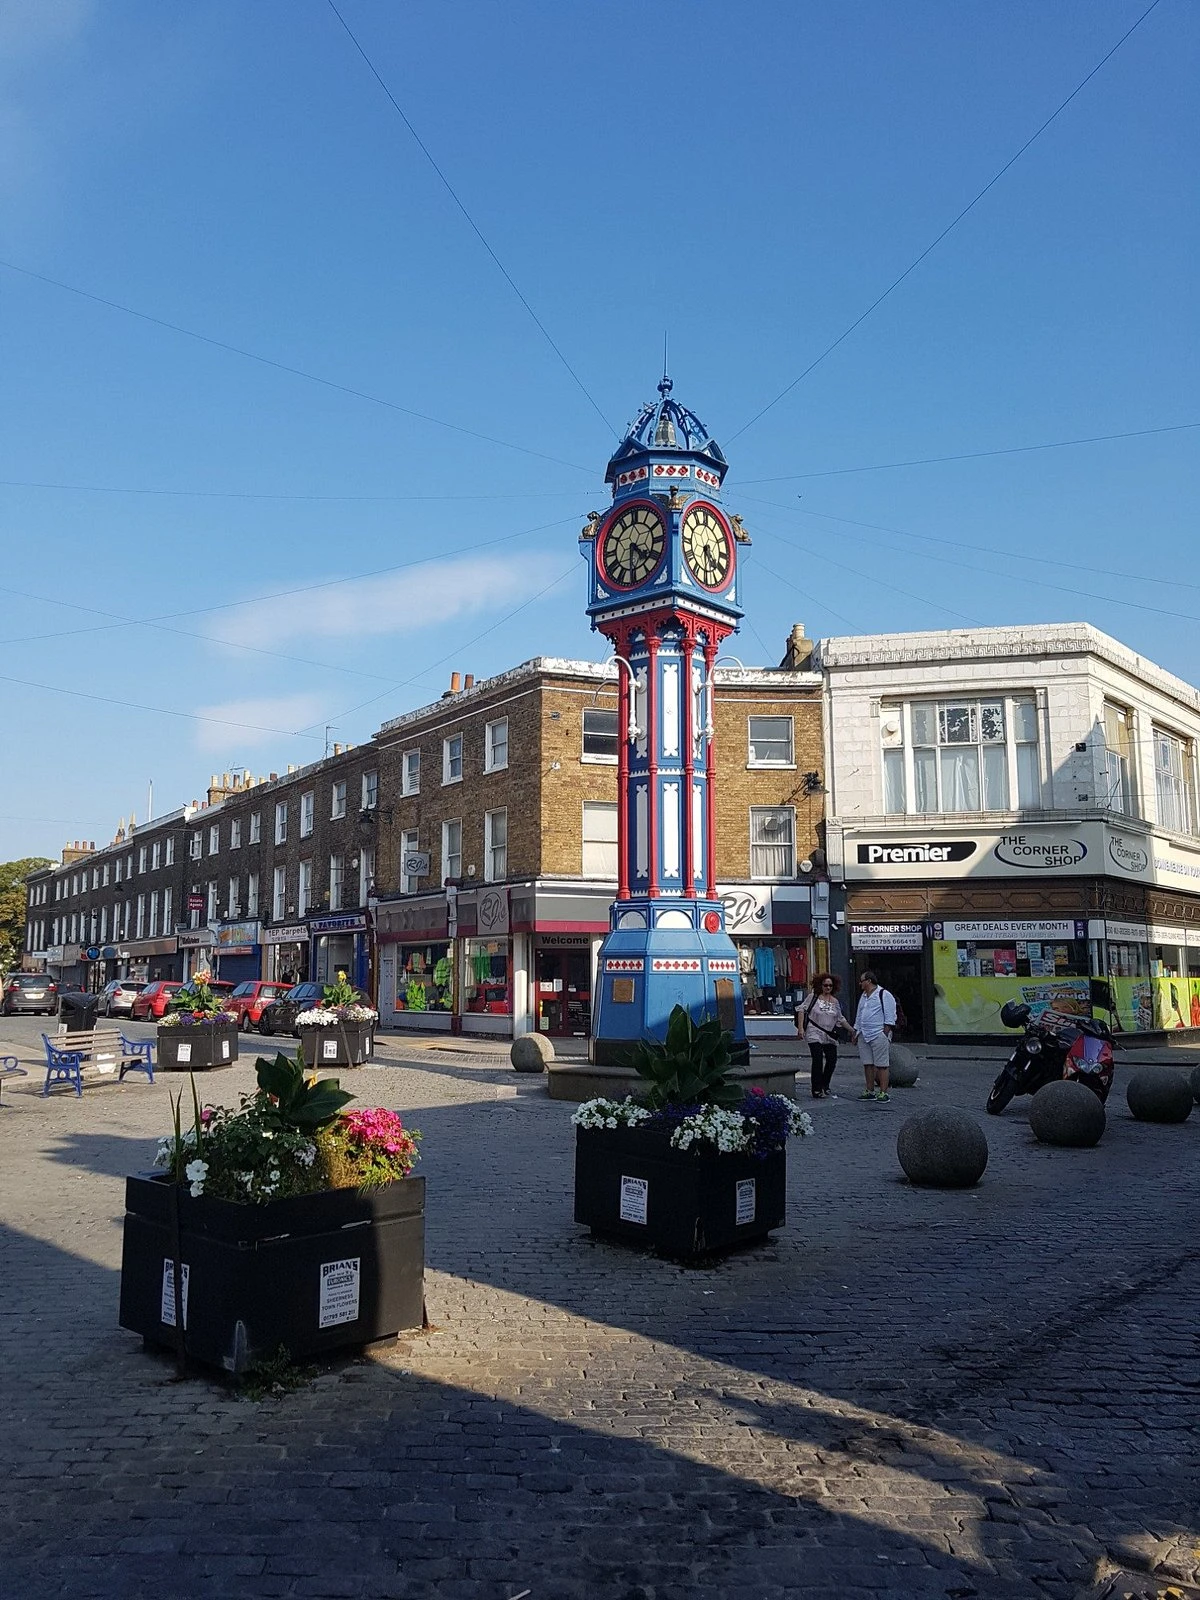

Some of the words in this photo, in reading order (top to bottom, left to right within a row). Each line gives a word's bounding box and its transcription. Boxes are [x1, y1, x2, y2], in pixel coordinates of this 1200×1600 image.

[1000, 835, 1026, 846] THE
[1110, 836, 1123, 848] THE
[868, 843, 952, 863] Premier
[1012, 845, 1069, 856] CORNER
[1116, 848, 1141, 862] CORNER
[1044, 855, 1081, 866] SHOP
[1130, 861, 1147, 872] SHOP
[282, 927, 307, 936] Carpets
[900, 924, 922, 932] SHOP
[954, 923, 982, 932] GREAT
[982, 922, 1009, 931] DEALS
[1011, 922, 1037, 931] EVERY
[1038, 922, 1069, 931] MONTH
[541, 935, 589, 945] Welcome
[622, 1177, 647, 1190] BRIAN'S
[322, 1260, 358, 1278] BRIAN'S
